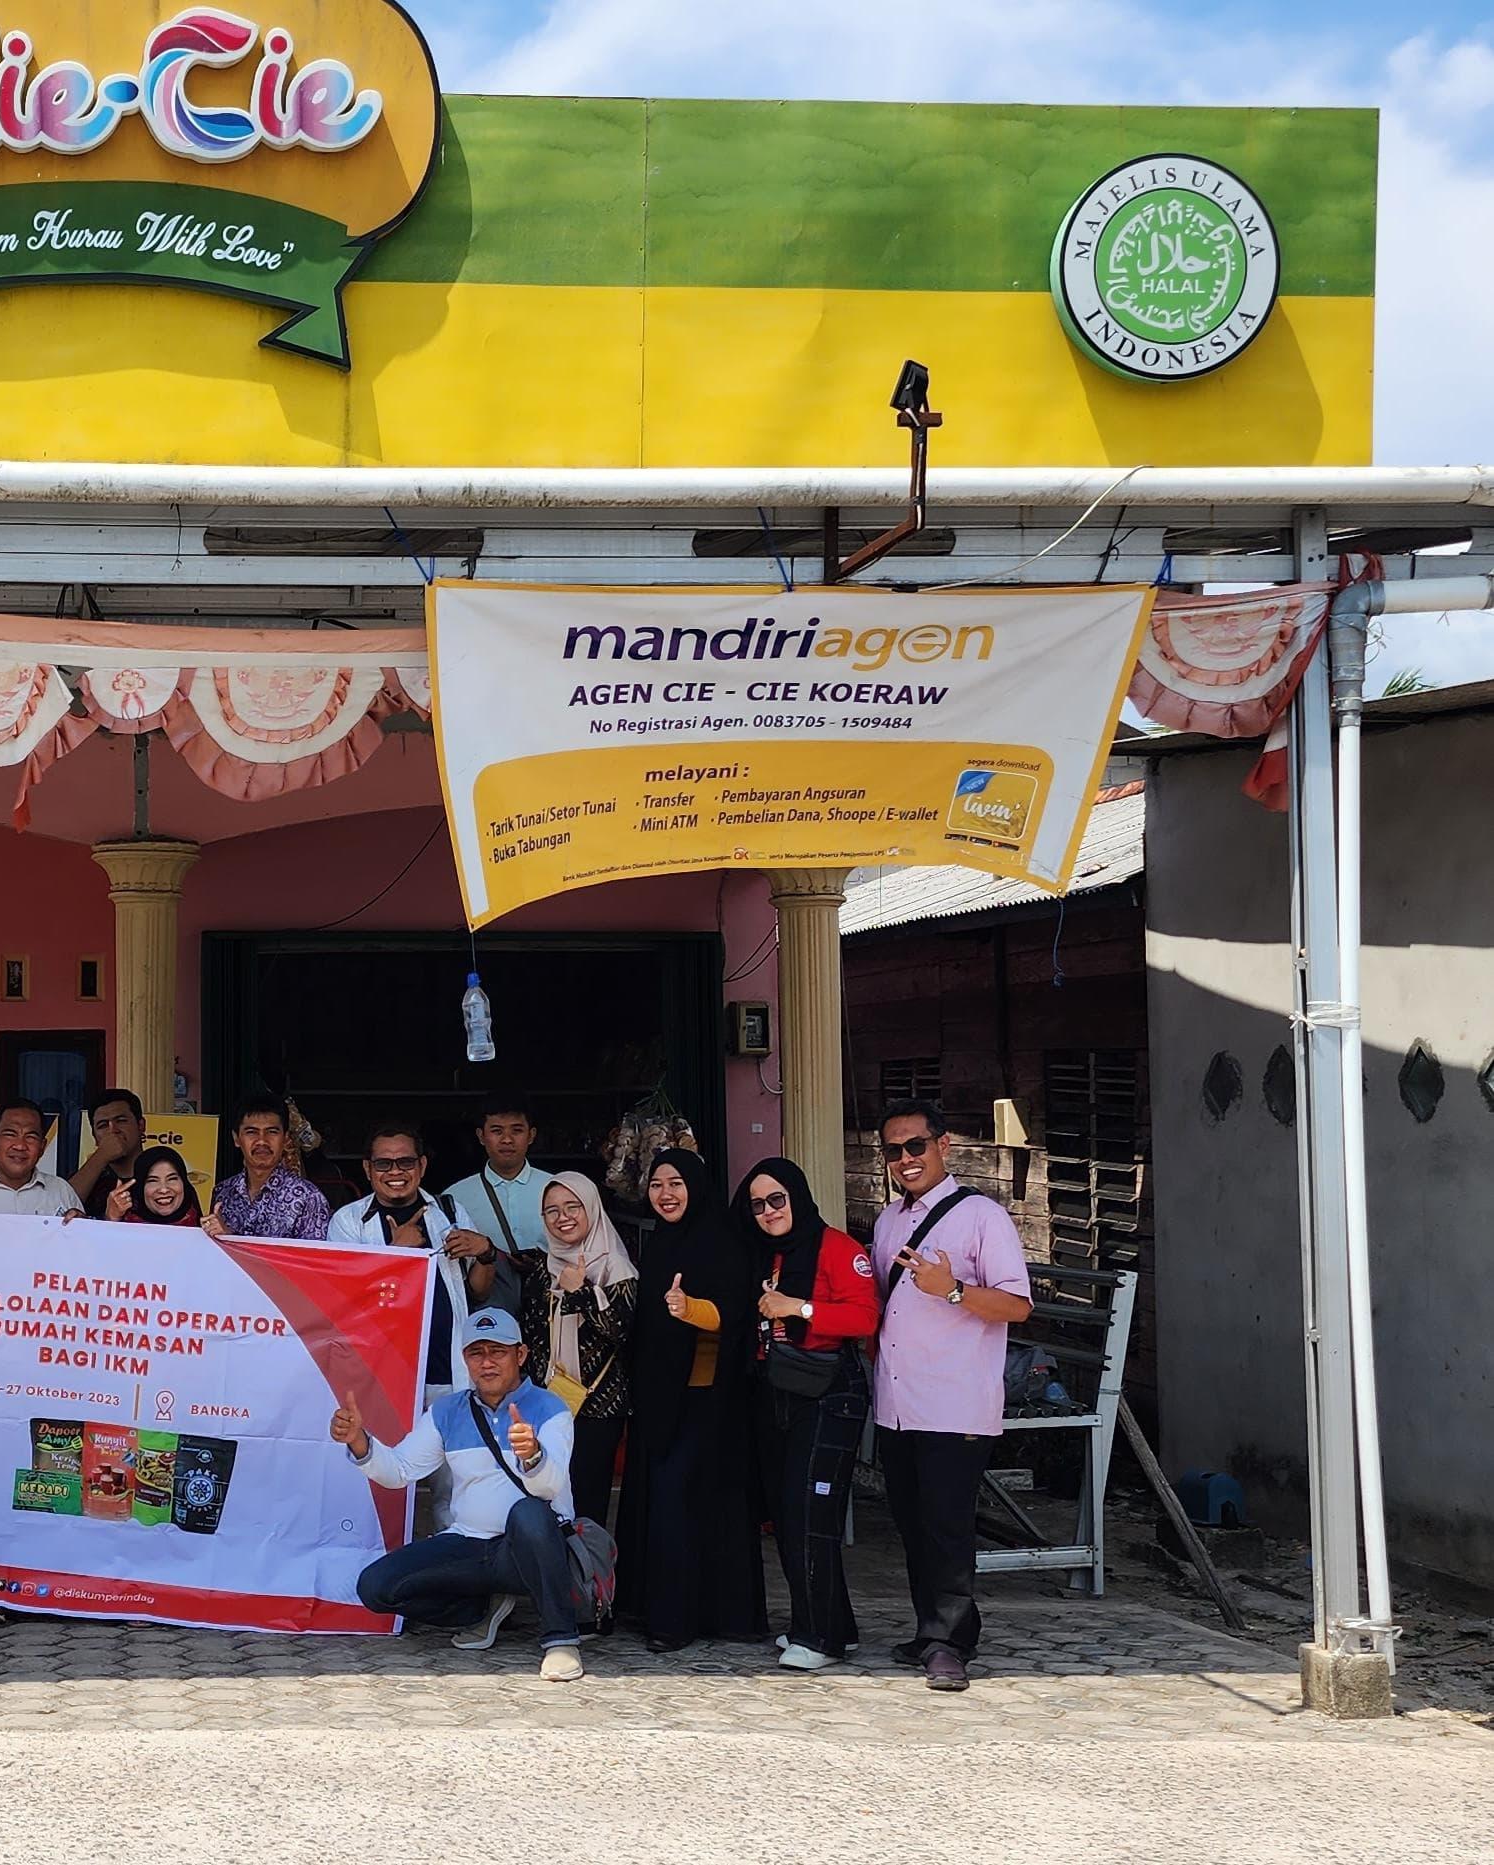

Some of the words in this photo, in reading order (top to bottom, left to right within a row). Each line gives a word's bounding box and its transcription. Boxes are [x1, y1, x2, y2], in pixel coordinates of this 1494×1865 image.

[1074, 167, 1177, 260] MAJELIS
[1191, 170, 1266, 258] ULAMA
[27, 209, 123, 250] Kurau
[136, 210, 216, 257] With
[1141, 279, 1206, 294] HALAL
[1083, 308, 1258, 370] INDONESIA
[562, 617, 995, 671] mandiriagen
[567, 683, 654, 707] AGEN
[662, 682, 716, 703] CIE
[746, 682, 800, 702] CIE
[809, 683, 949, 705] KOERAW
[590, 719, 612, 734] No
[617, 716, 698, 735] Registrasi
[700, 716, 748, 731] Agen.
[753, 715, 826, 728] 0083705
[841, 716, 913, 729] 1509484
[644, 763, 739, 783] melayani
[966, 759, 996, 767] segera
[996, 758, 1042, 771] download
[643, 792, 695, 810] Transfer
[721, 788, 801, 805] Pembayaran
[803, 786, 866, 804] Angsuran
[490, 816, 515, 839] Tarik
[515, 805, 581, 829] Tunai/Setor
[582, 798, 617, 816] Tunai
[640, 816, 668, 833] Mini
[670, 814, 698, 829] ATM
[717, 808, 785, 826] Pembelian
[787, 808, 824, 823] Dana,
[826, 807, 876, 823] Shoope
[886, 807, 939, 821] E-wallet
[493, 843, 517, 865] Buka
[517, 831, 571, 856] Tabungan
[32, 1272, 167, 1301] PELATIHAN
[98, 1304, 149, 1326] DAN
[156, 1310, 286, 1337] OPERATOR
[84, 1329, 204, 1355] KEMASAN
[38, 1346, 97, 1370] BAGI
[105, 1354, 150, 1377] IKM
[25, 1385, 84, 1402] Oktober
[87, 1391, 121, 1408] 2023
[190, 1404, 251, 1419] BANGKA
[54, 1586, 155, 1604] @diskumperindag
